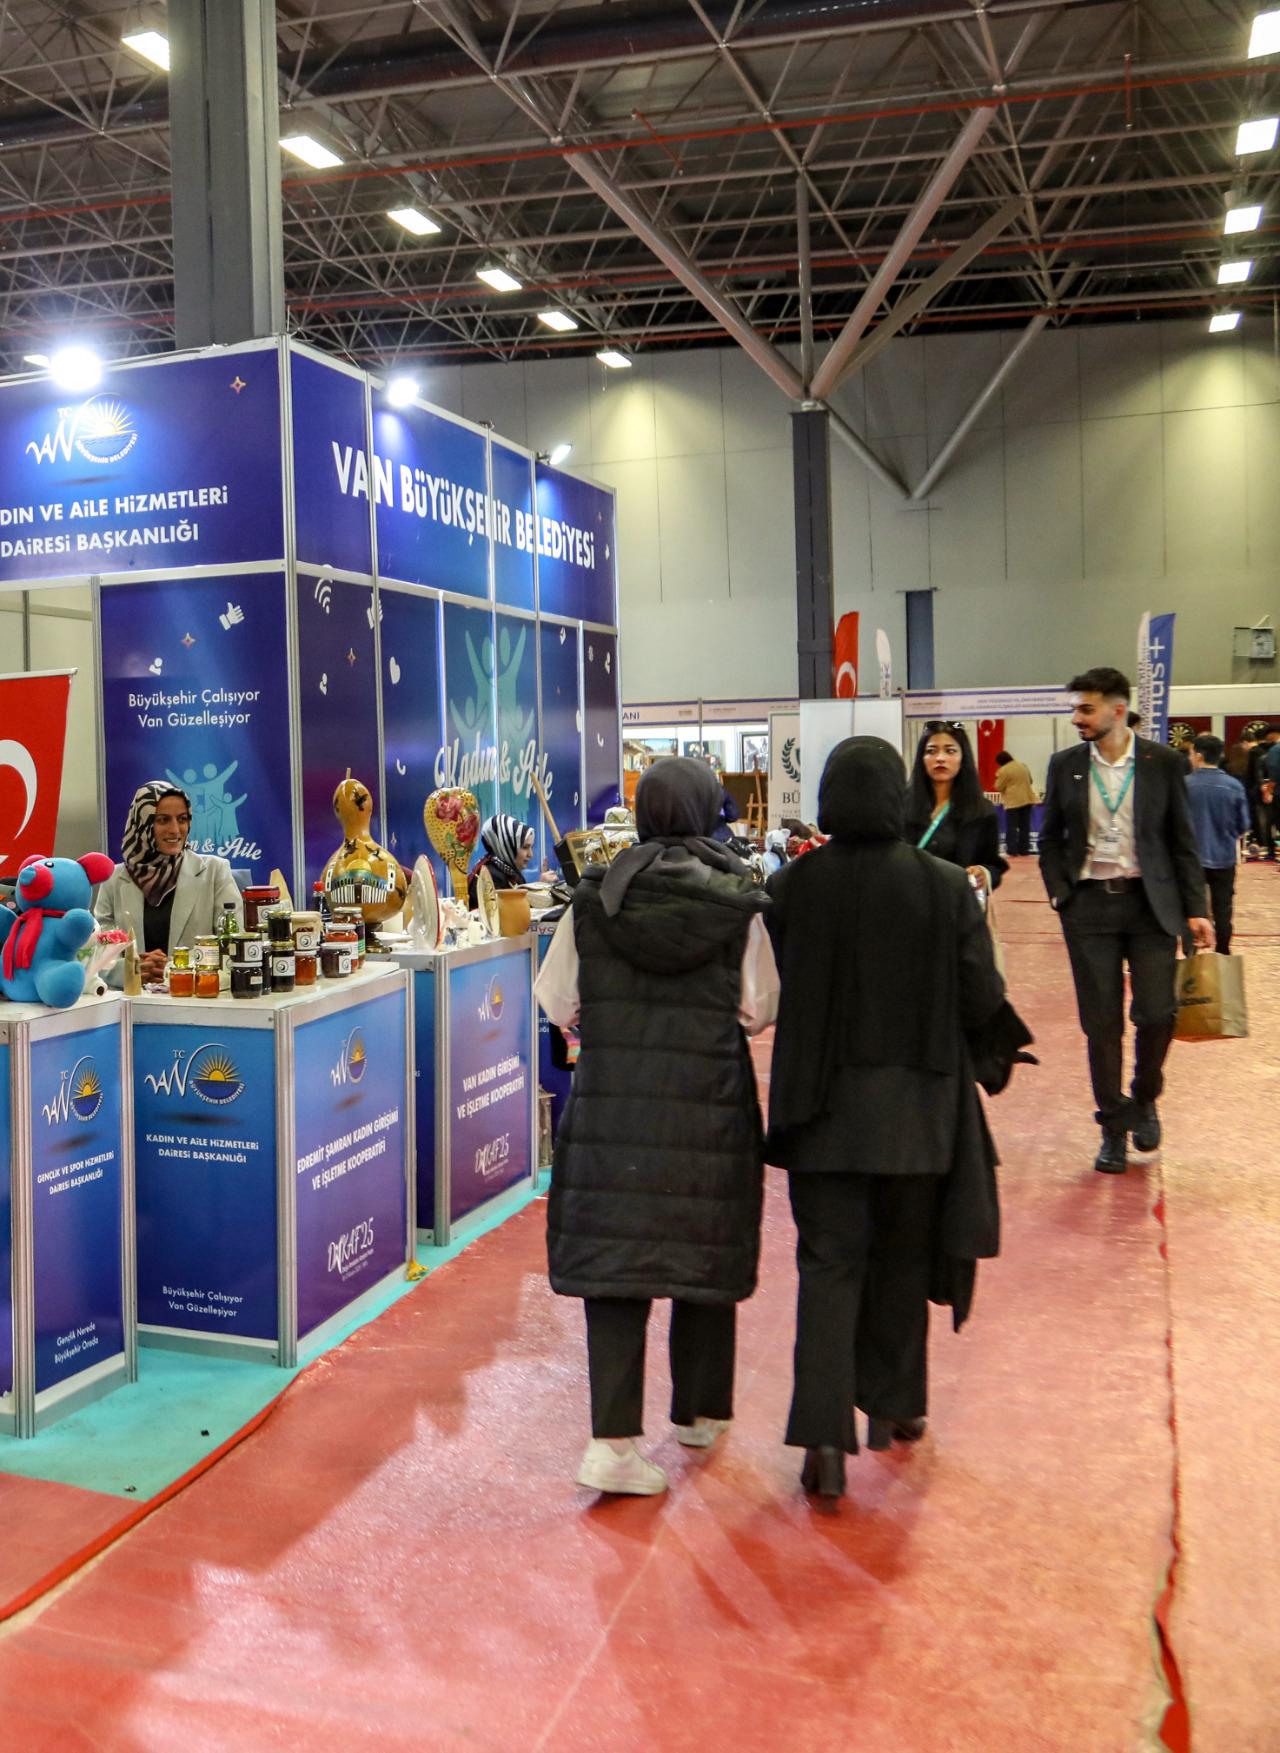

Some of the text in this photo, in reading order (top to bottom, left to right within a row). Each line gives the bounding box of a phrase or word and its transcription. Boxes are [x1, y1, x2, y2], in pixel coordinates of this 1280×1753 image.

[332, 441, 394, 507] VAN
[40, 504, 63, 522] VE
[76, 519, 199, 554] BAŞKANLIĞI
[129, 688, 260, 710] Büyükşehir Çalışıyor
[138, 710, 251, 728] Van Güzelleşiyor
[218, 837, 262, 860] Aile
[172, 1049, 185, 1058] TC
[463, 1076, 477, 1092] VAN
[456, 1105, 466, 1120] VE
[146, 1134, 174, 1143] KADIN
[177, 1136, 188, 1144] VE
[353, 1123, 373, 1144] KADIN
[193, 1151, 246, 1163] BAŞKANLIĞI
[62, 1166, 69, 1175] VE
[70, 1161, 84, 1173] SPOR
[312, 1174, 321, 1190] VE
[322, 1163, 346, 1188] İŞLETME
[162, 1286, 243, 1304] Büyükşehir Çalışıyor
[168, 1300, 237, 1317] Van Güzelleşiyor
